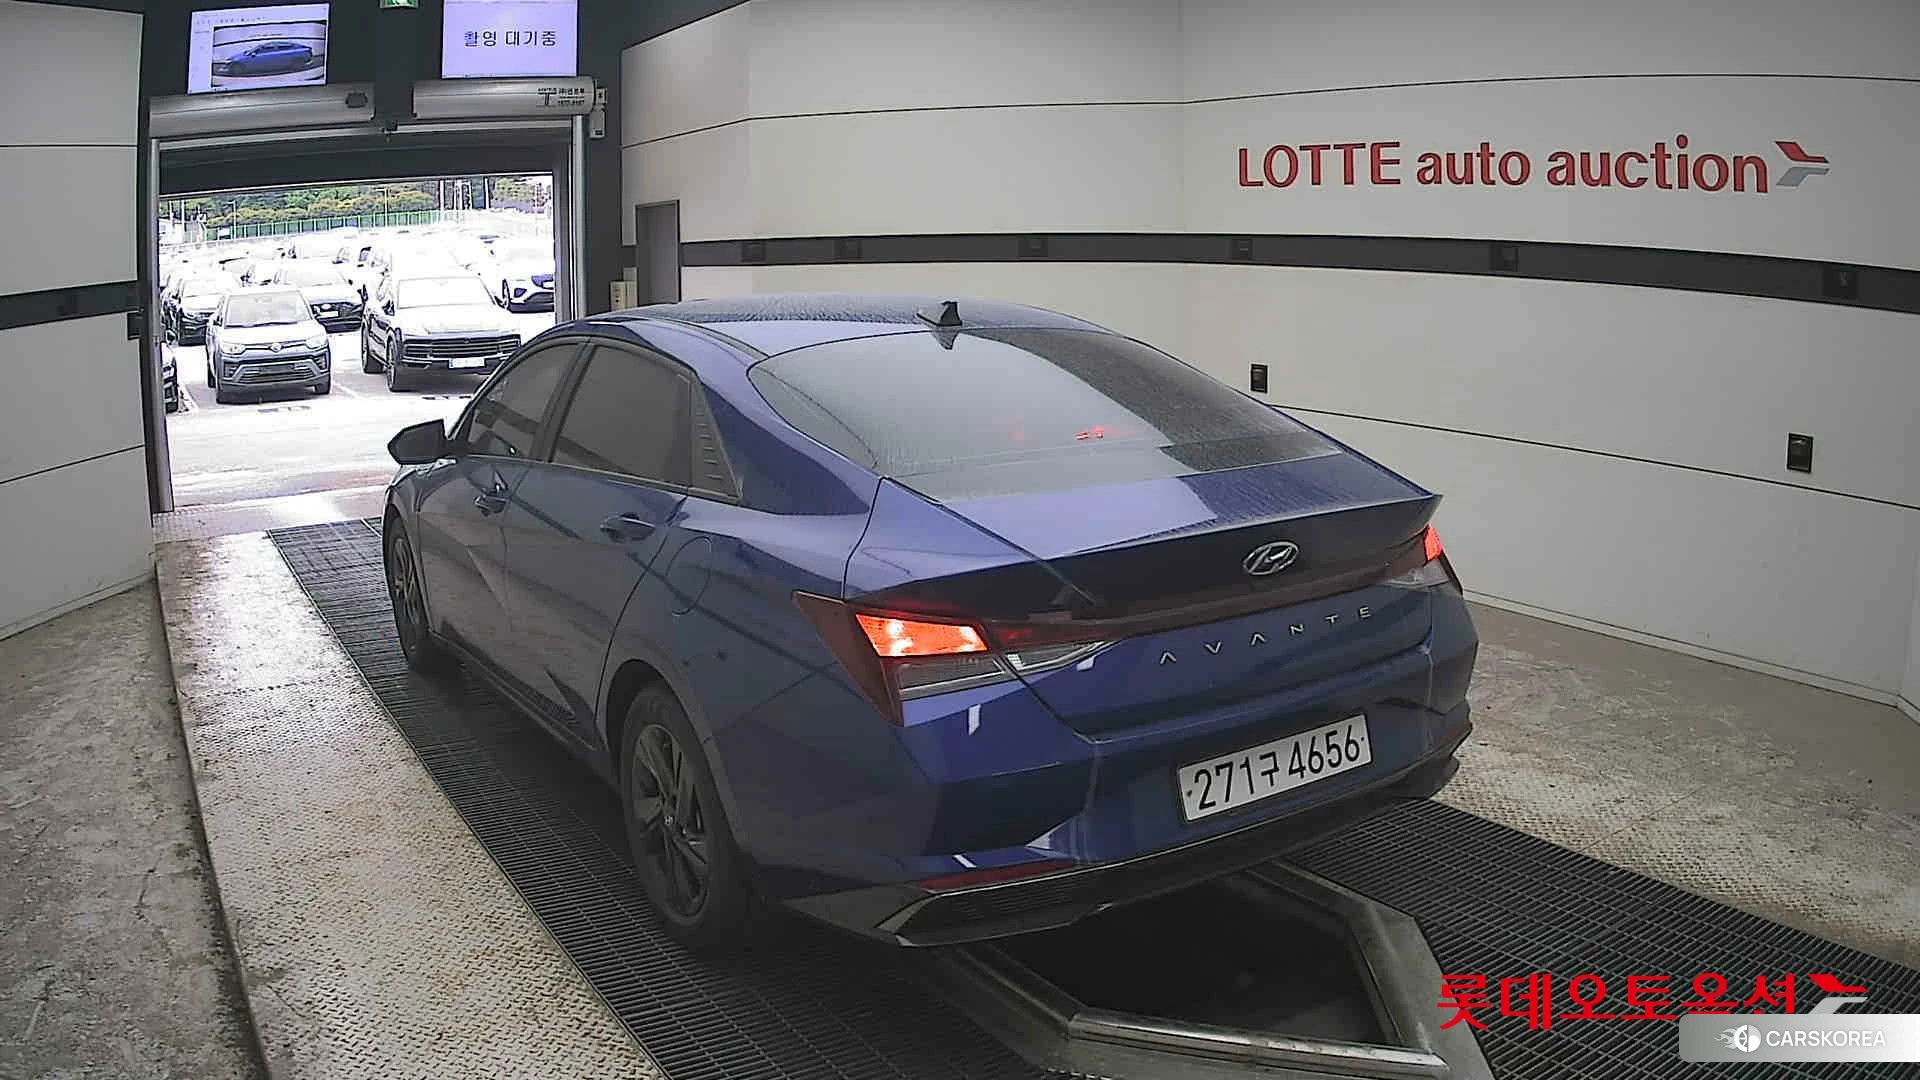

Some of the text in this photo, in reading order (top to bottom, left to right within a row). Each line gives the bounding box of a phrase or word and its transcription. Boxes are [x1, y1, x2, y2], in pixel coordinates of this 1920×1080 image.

[505, 30, 556, 47] 대기중
[1238, 134, 1769, 194] LOTTE auto auction
[1159, 606, 1371, 665] AVANTE
[1287, 724, 1361, 780] 4656
